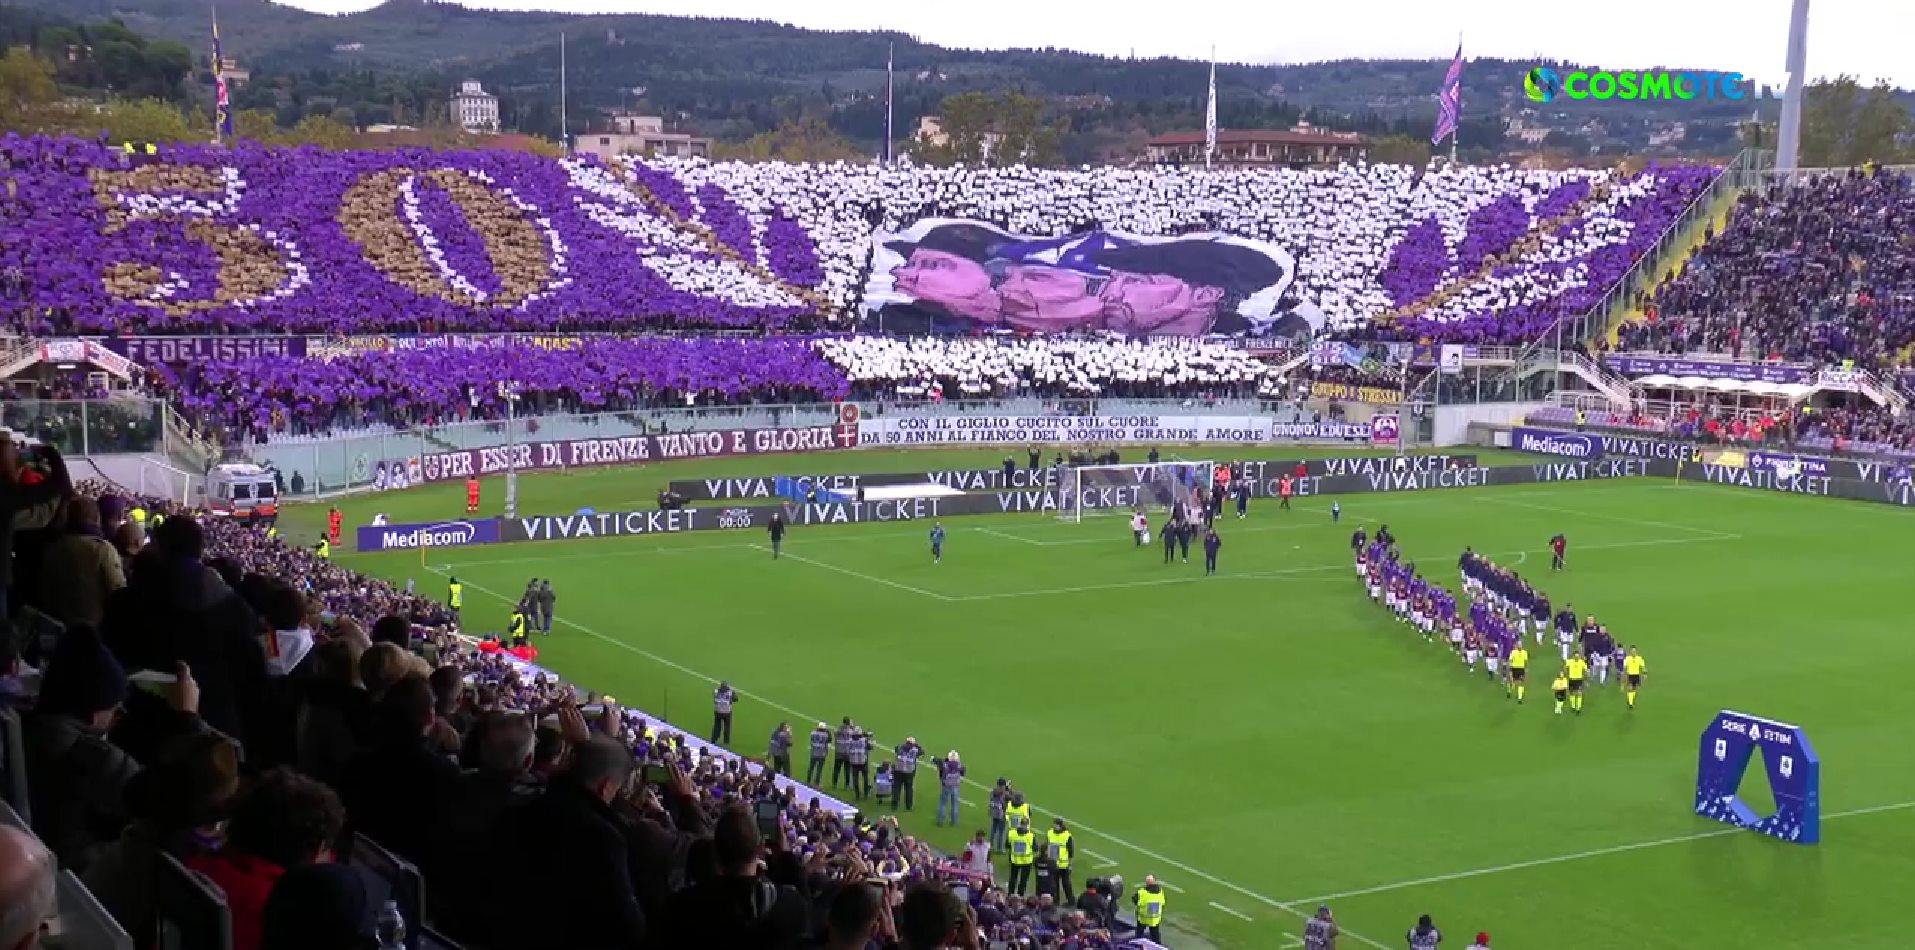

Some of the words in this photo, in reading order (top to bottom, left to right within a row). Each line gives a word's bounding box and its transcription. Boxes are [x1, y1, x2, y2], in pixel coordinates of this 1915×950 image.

[899, 418, 929, 429] CON
[936, 418, 951, 429] IL
[956, 418, 1010, 429] GIGLIO
[1016, 418, 1072, 429] CUCITO
[1077, 417, 1104, 428] SUL
[1108, 416, 1160, 427] CUORE
[861, 431, 880, 443] DA
[886, 431, 900, 443] 50
[905, 430, 943, 442] ANNI
[948, 430, 967, 441] AL
[971, 430, 1027, 441] FIANCO
[1032, 430, 1060, 441] DEL
[1067, 429, 1127, 441] NOSTRO
[1134, 428, 1198, 440] GRANDE
[1206, 428, 1264, 441] AMORE
[1521, 434, 1586, 456] Mediacom
[441, 453, 475, 477] PER
[479, 444, 534, 474] ESSER
[541, 443, 562, 466] DI
[570, 437, 649, 465] FIRENZE
[656, 432, 724, 457] VANTO
[731, 431, 746, 452] E
[755, 428, 835, 450] GLORIA
[1533, 459, 1651, 481] VIVATICKET
[1765, 458, 1826, 472] FIORETINA
[1369, 468, 1490, 491] VIVATICKET
[997, 485, 1141, 511] VIVATCKET
[783, 497, 940, 525] VIVATICKET
[522, 508, 697, 540] VIVATICKET
[383, 529, 467, 549] Mediacom
